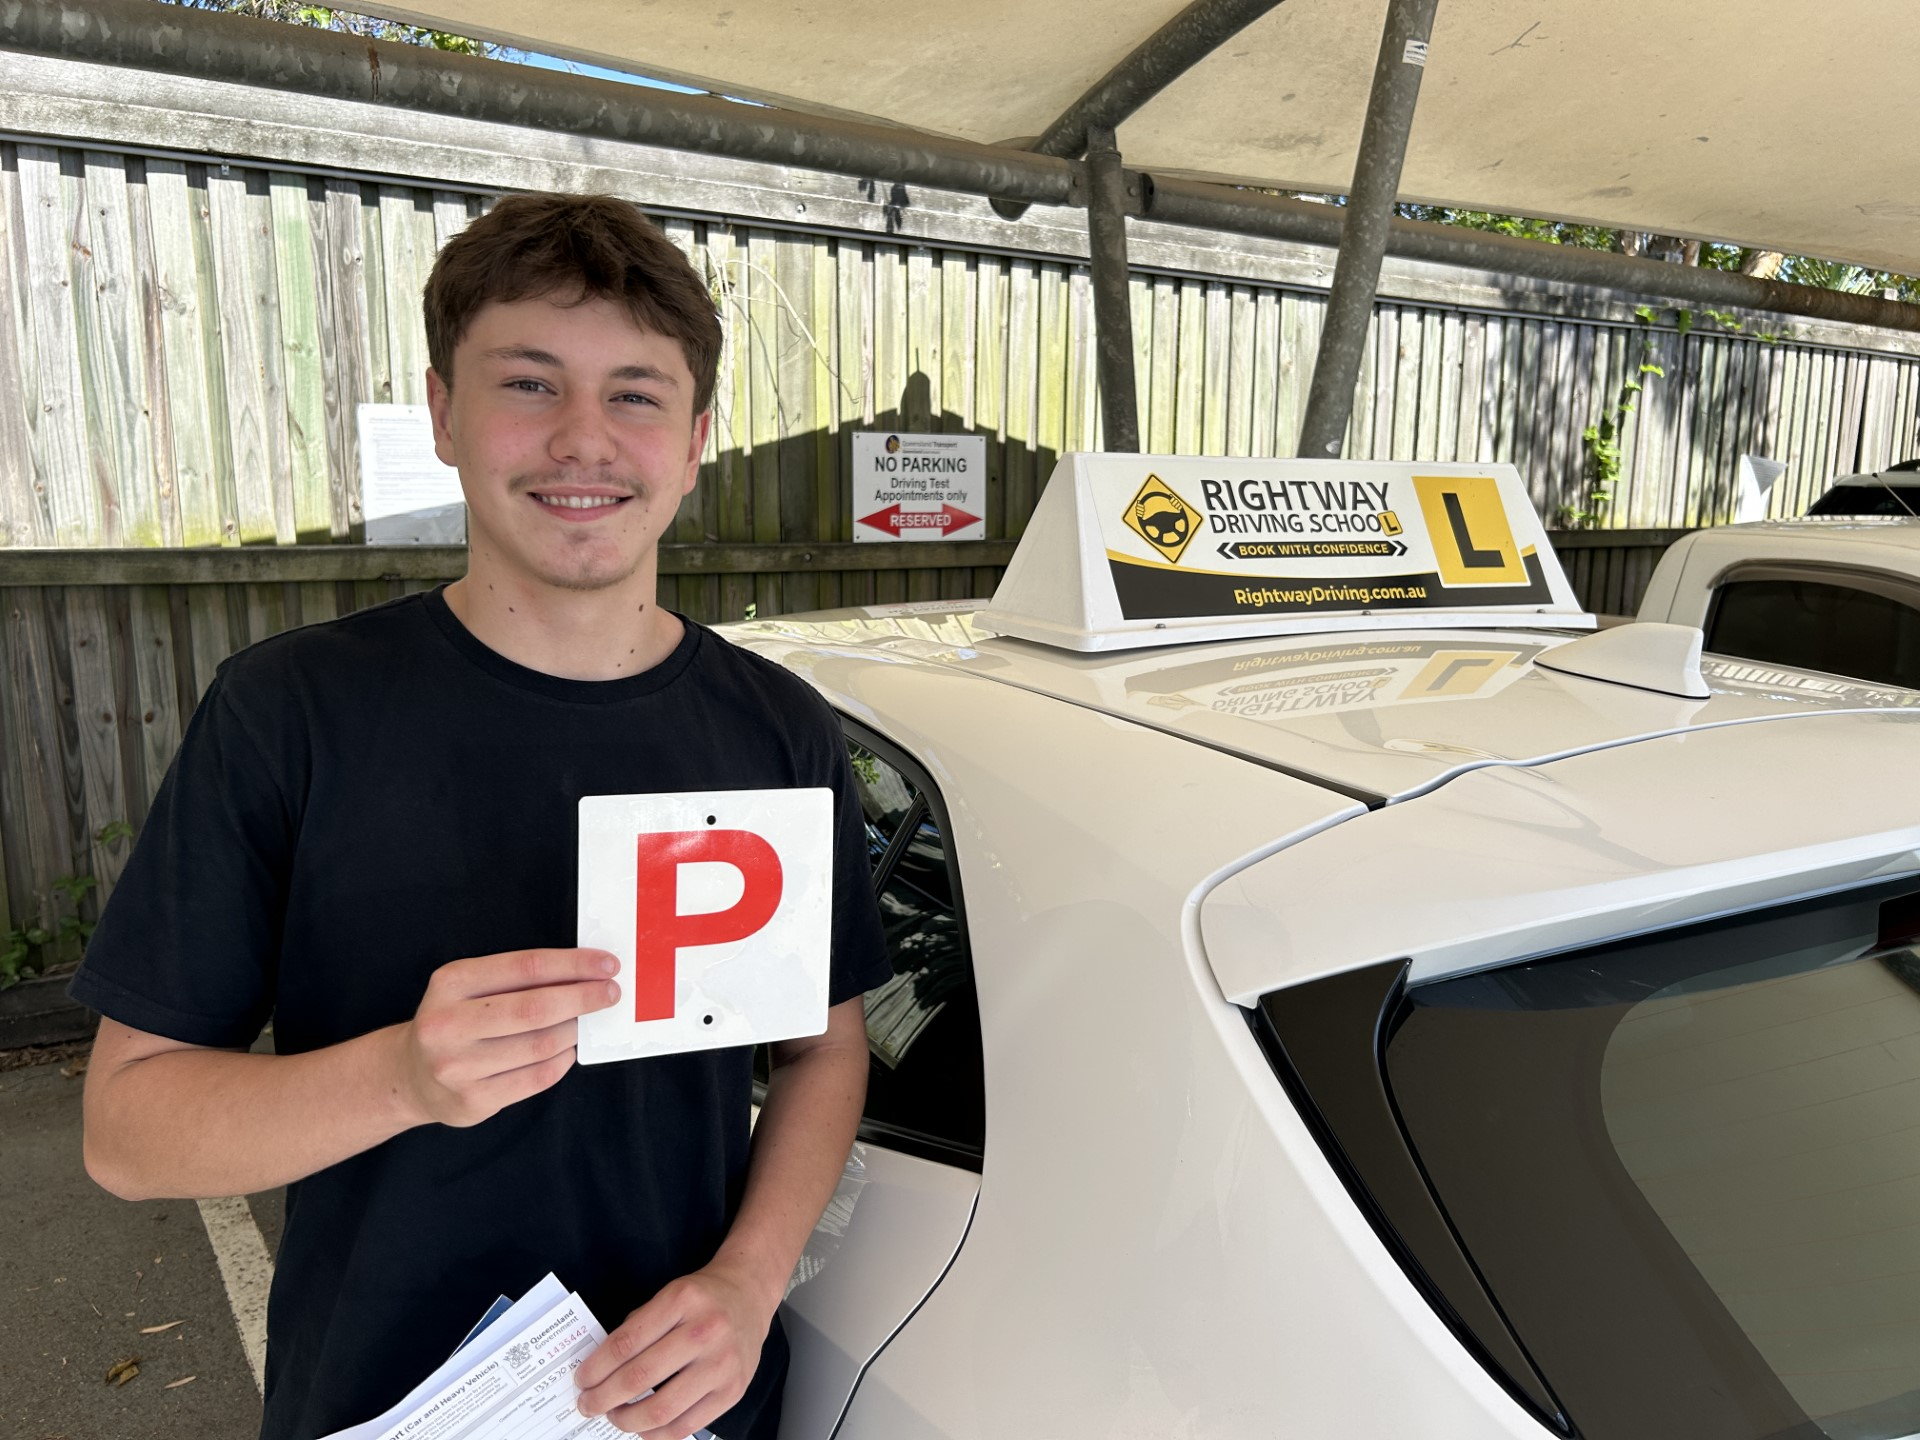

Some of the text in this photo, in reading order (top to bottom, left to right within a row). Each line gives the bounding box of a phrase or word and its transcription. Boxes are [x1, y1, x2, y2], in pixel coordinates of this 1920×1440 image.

[875, 457, 967, 473] NO PARKING
[875, 490, 968, 503] Appointments only
[891, 477, 950, 491] Driving Test
[1200, 479, 1389, 512] RIGHTWAY
[890, 514, 952, 527] RESERVED
[1209, 513, 1401, 534] DRIVING SCHOOL
[1441, 492, 1506, 568] L
[1239, 543, 1389, 556] BOOK WITH CONFIDENCE
[1233, 584, 1427, 607] RightwayDriving.com.au
[635, 829, 784, 1023] P
[530, 1308, 575, 1344] Queensland
[535, 1315, 579, 1350] Government
[547, 1325, 589, 1359] 1435442
[404, 1418, 423, 1433] (Car
[423, 1404, 440, 1419] and
[440, 1385, 466, 1406] Heavy
[465, 1361, 499, 1386] Vehicle)
